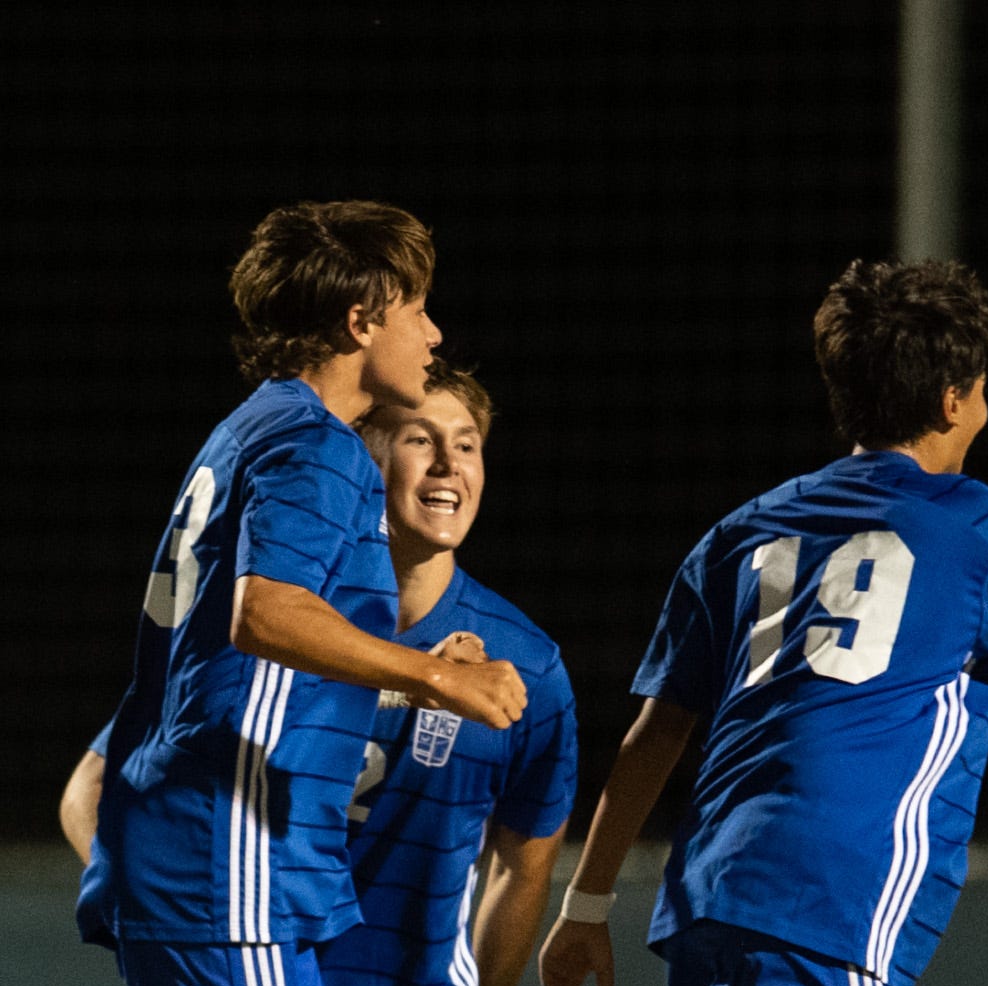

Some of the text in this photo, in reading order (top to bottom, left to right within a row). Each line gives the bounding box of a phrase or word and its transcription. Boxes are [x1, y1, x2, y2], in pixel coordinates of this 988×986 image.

[143, 466, 216, 629] 3
[742, 530, 916, 688] 19
[346, 740, 388, 823] 2
